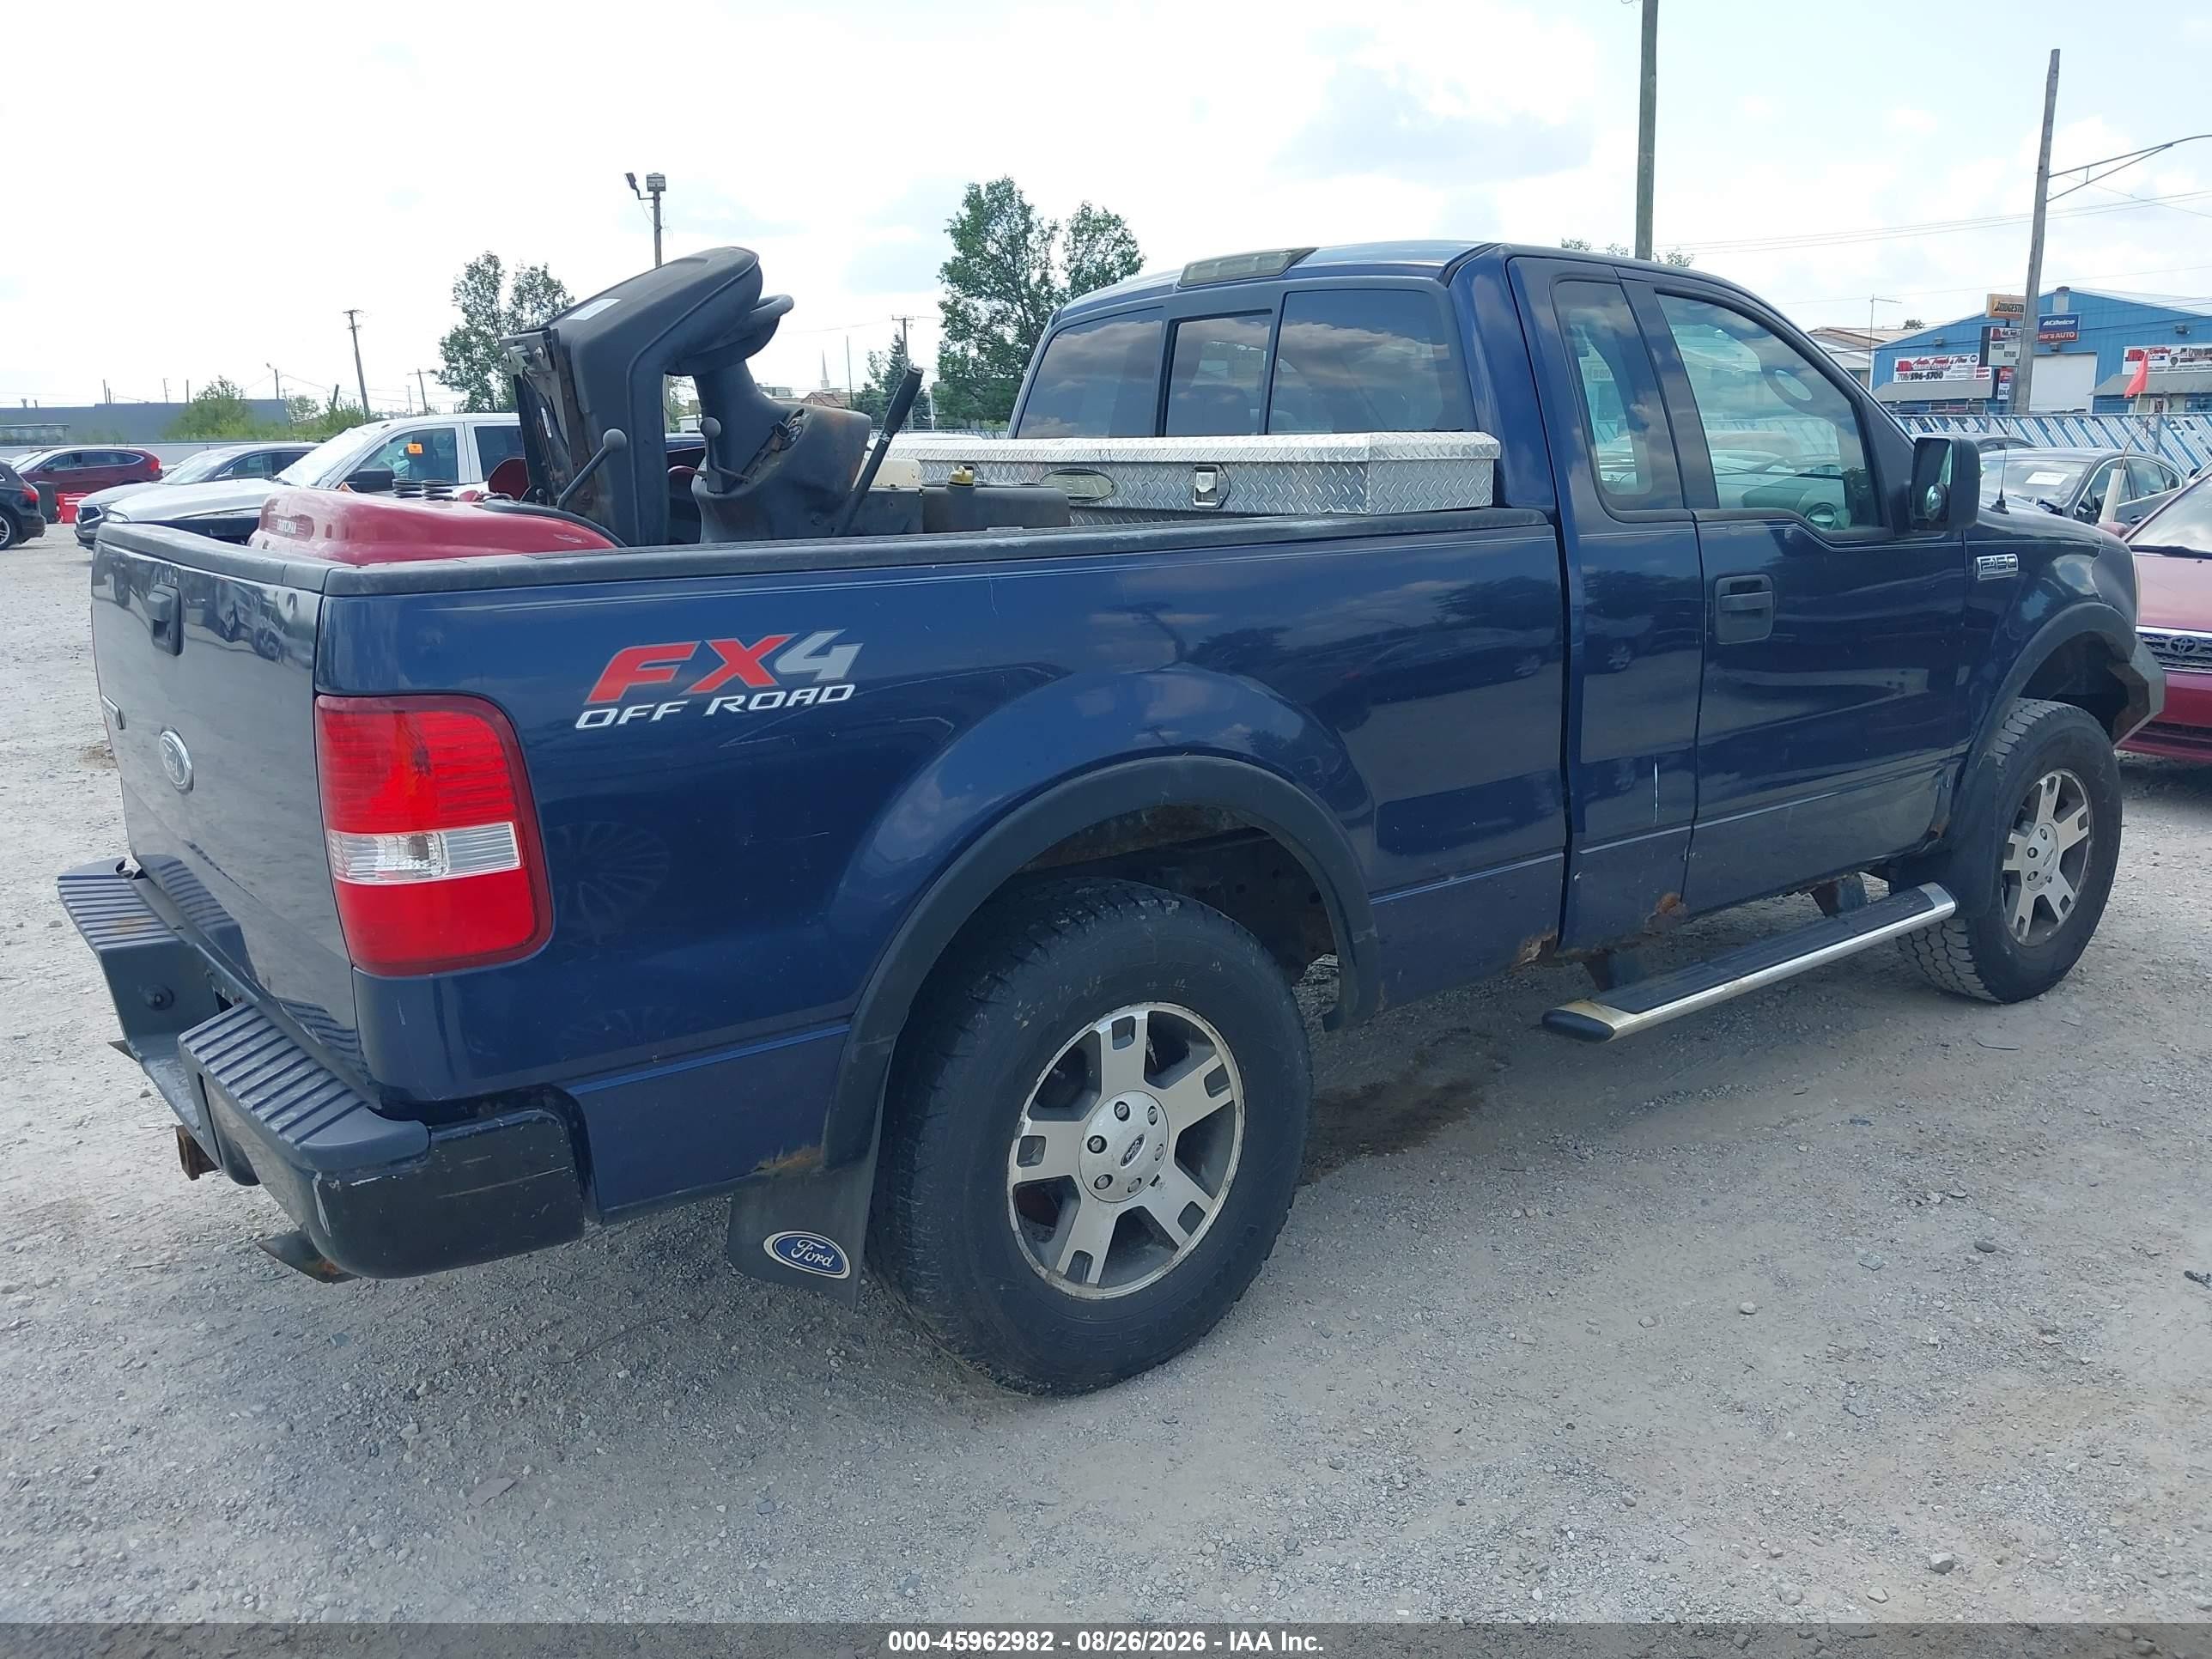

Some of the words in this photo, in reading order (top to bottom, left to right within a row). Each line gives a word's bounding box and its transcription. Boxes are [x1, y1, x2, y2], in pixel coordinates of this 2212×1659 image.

[584, 629, 864, 705] FX4
[575, 699, 690, 730] OFF
[702, 684, 857, 717] ROAD
[791, 1239, 835, 1267] Ford
